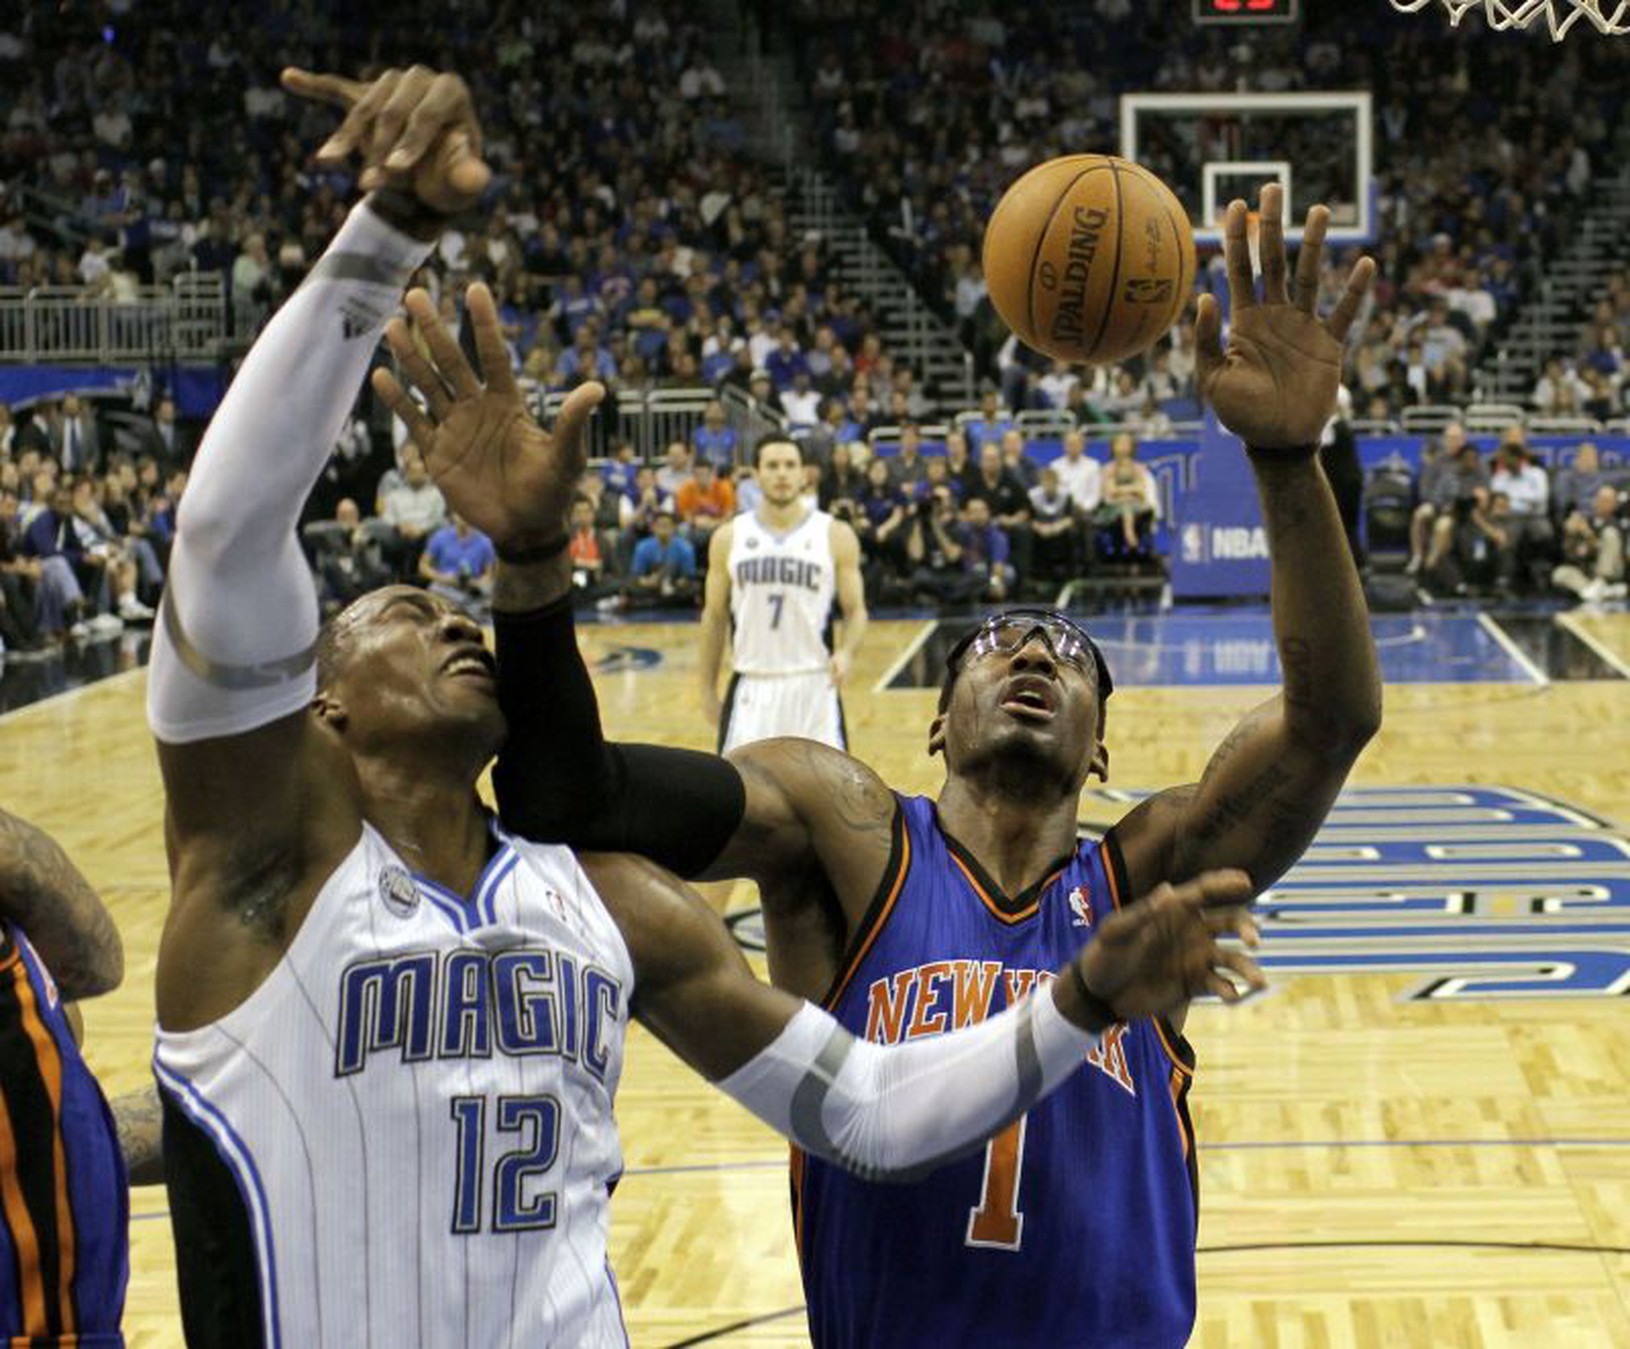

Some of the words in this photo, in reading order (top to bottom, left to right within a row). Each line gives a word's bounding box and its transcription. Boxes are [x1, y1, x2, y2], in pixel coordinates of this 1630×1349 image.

[1053, 206, 1109, 346] SPALDING
[736, 555, 821, 592] MAGIC
[1212, 526, 1271, 560] NBA
[767, 594, 785, 630] 7
[334, 948, 622, 1085] MAGIC
[864, 958, 1003, 1046] NEW
[450, 1094, 562, 1235] 12
[964, 1113, 1027, 1252] 1
